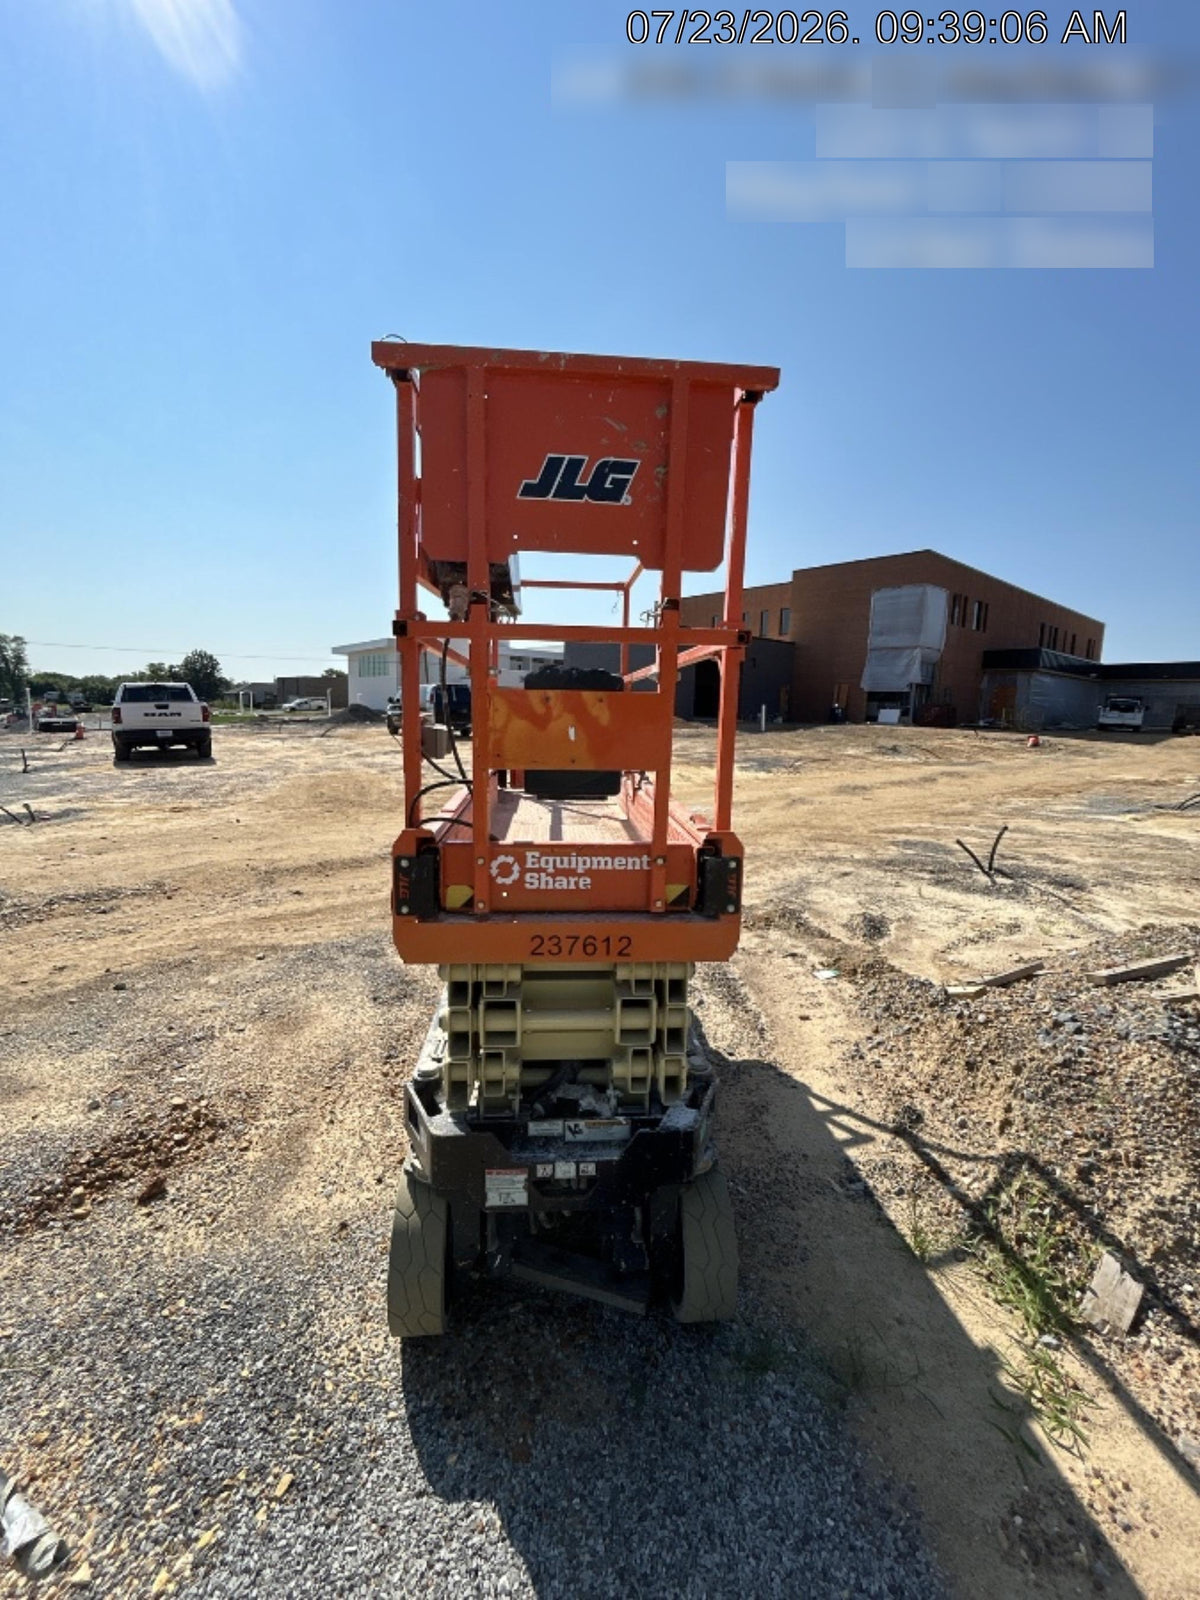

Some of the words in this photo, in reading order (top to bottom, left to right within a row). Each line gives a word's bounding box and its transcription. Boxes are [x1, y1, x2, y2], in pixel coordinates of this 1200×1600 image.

[517, 453, 641, 505] JLG
[525, 851, 651, 873] Equipment
[524, 873, 591, 890] Share
[530, 934, 632, 957] 237612
